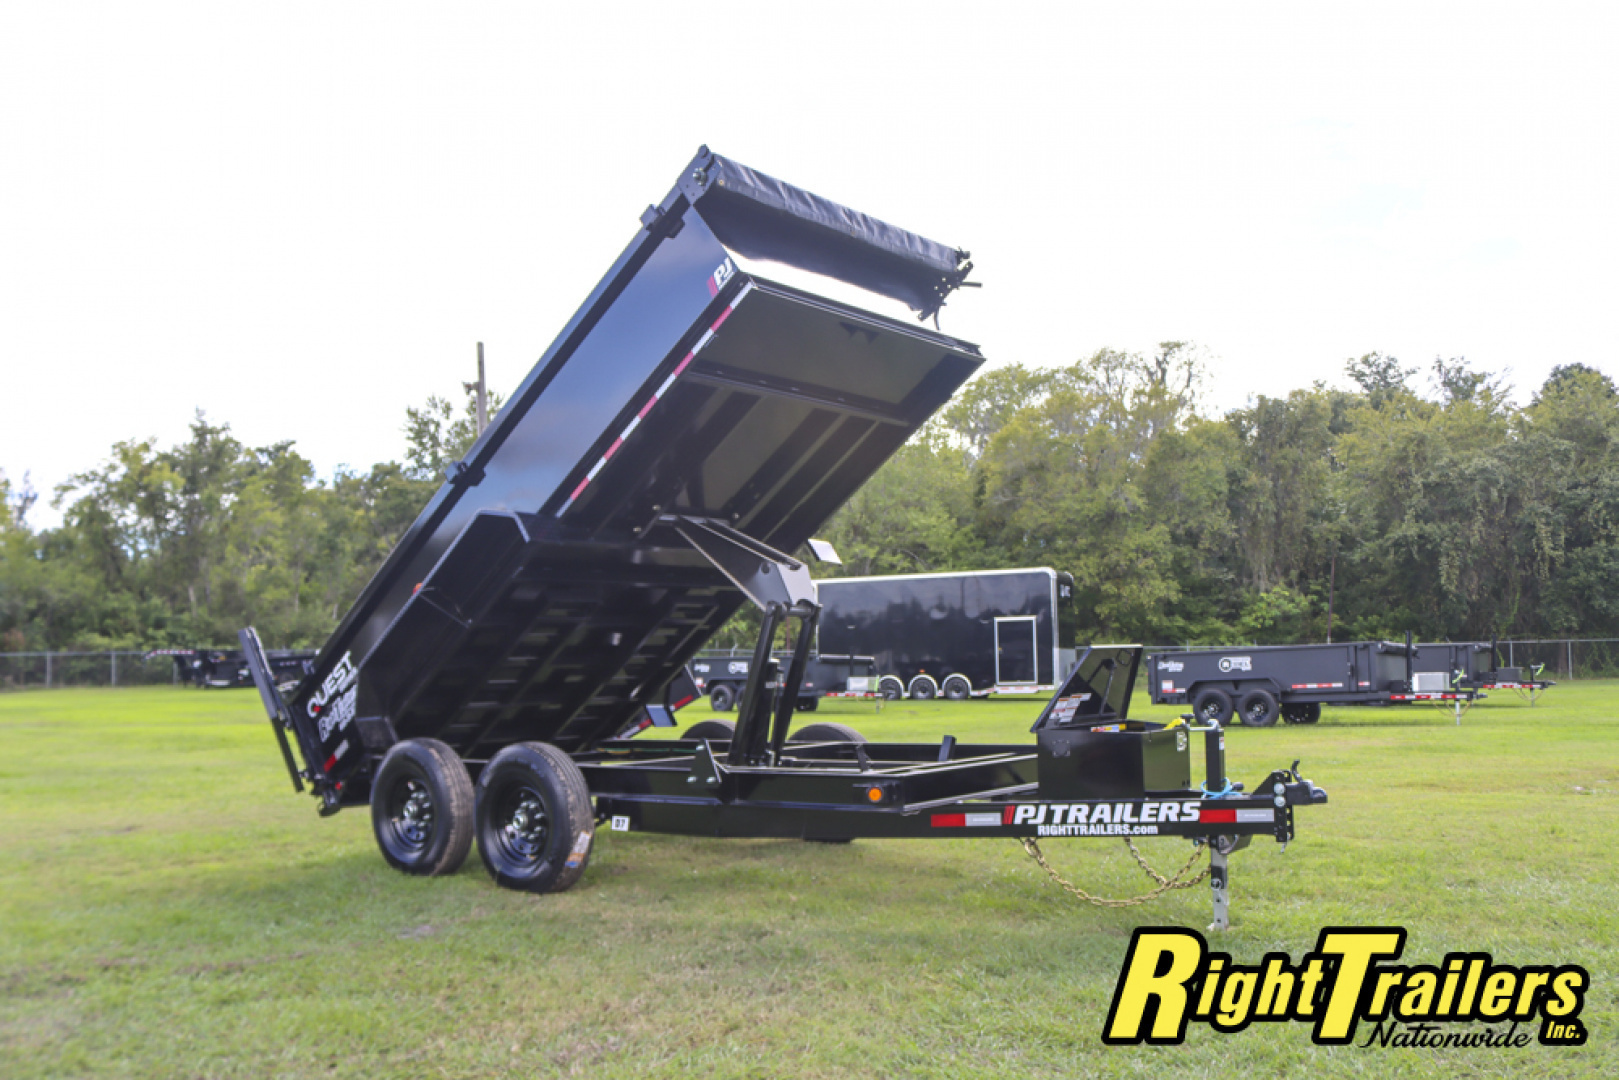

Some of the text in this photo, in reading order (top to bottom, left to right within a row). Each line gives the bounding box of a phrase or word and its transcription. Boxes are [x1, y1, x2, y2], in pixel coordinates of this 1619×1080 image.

[713, 257, 732, 286] PJ
[306, 650, 352, 718] QUEST
[1037, 824, 1159, 836] RIGHTTRAILERS.com
